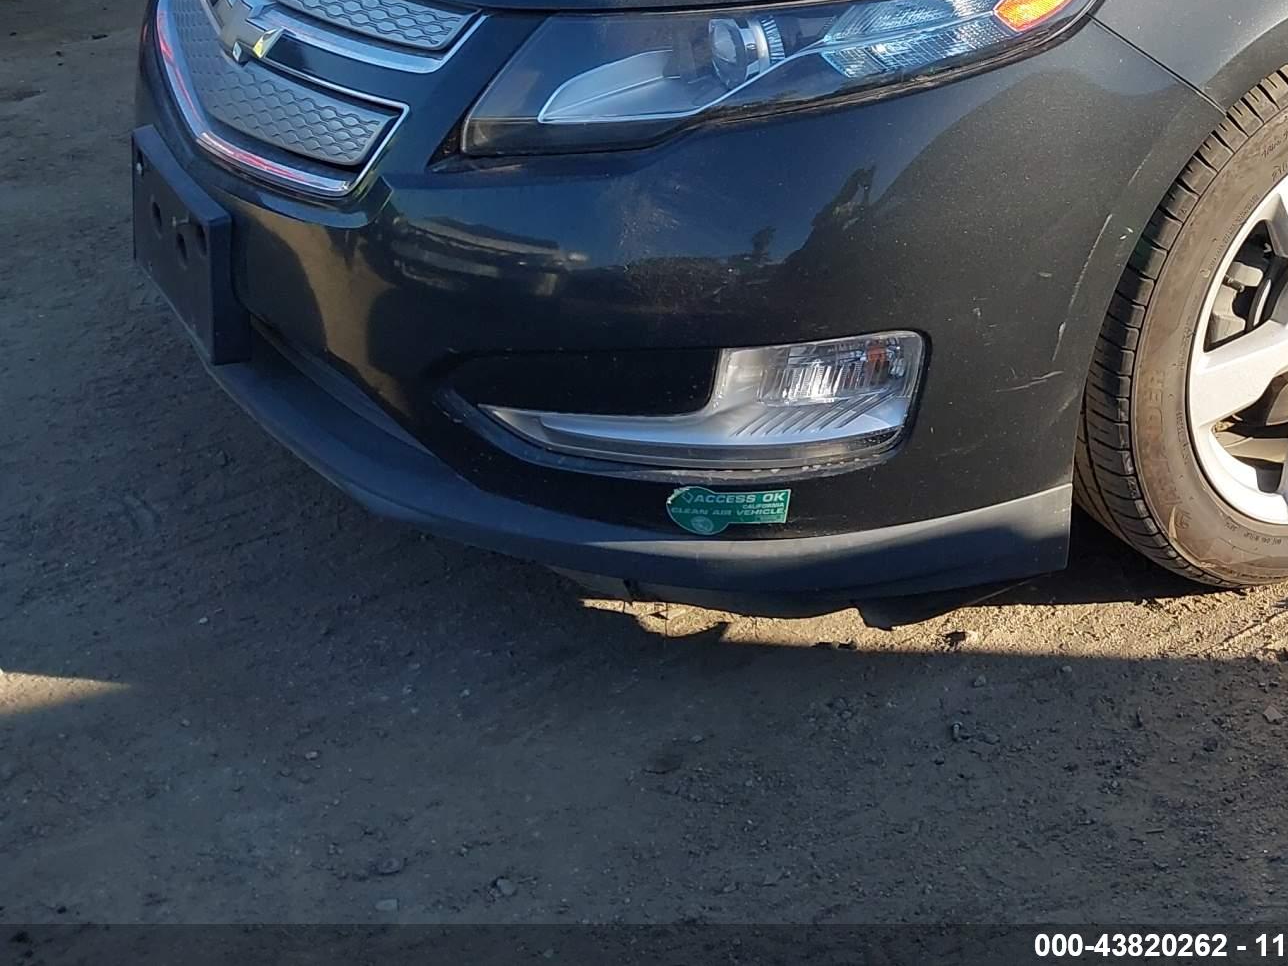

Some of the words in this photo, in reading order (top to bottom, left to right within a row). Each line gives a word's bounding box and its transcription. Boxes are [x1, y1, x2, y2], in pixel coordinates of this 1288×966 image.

[693, 494, 756, 504] ACCESS
[762, 492, 785, 503] OK
[671, 507, 708, 515] CLEAN
[712, 508, 732, 516] AIR
[736, 507, 785, 516] VEHICLE
